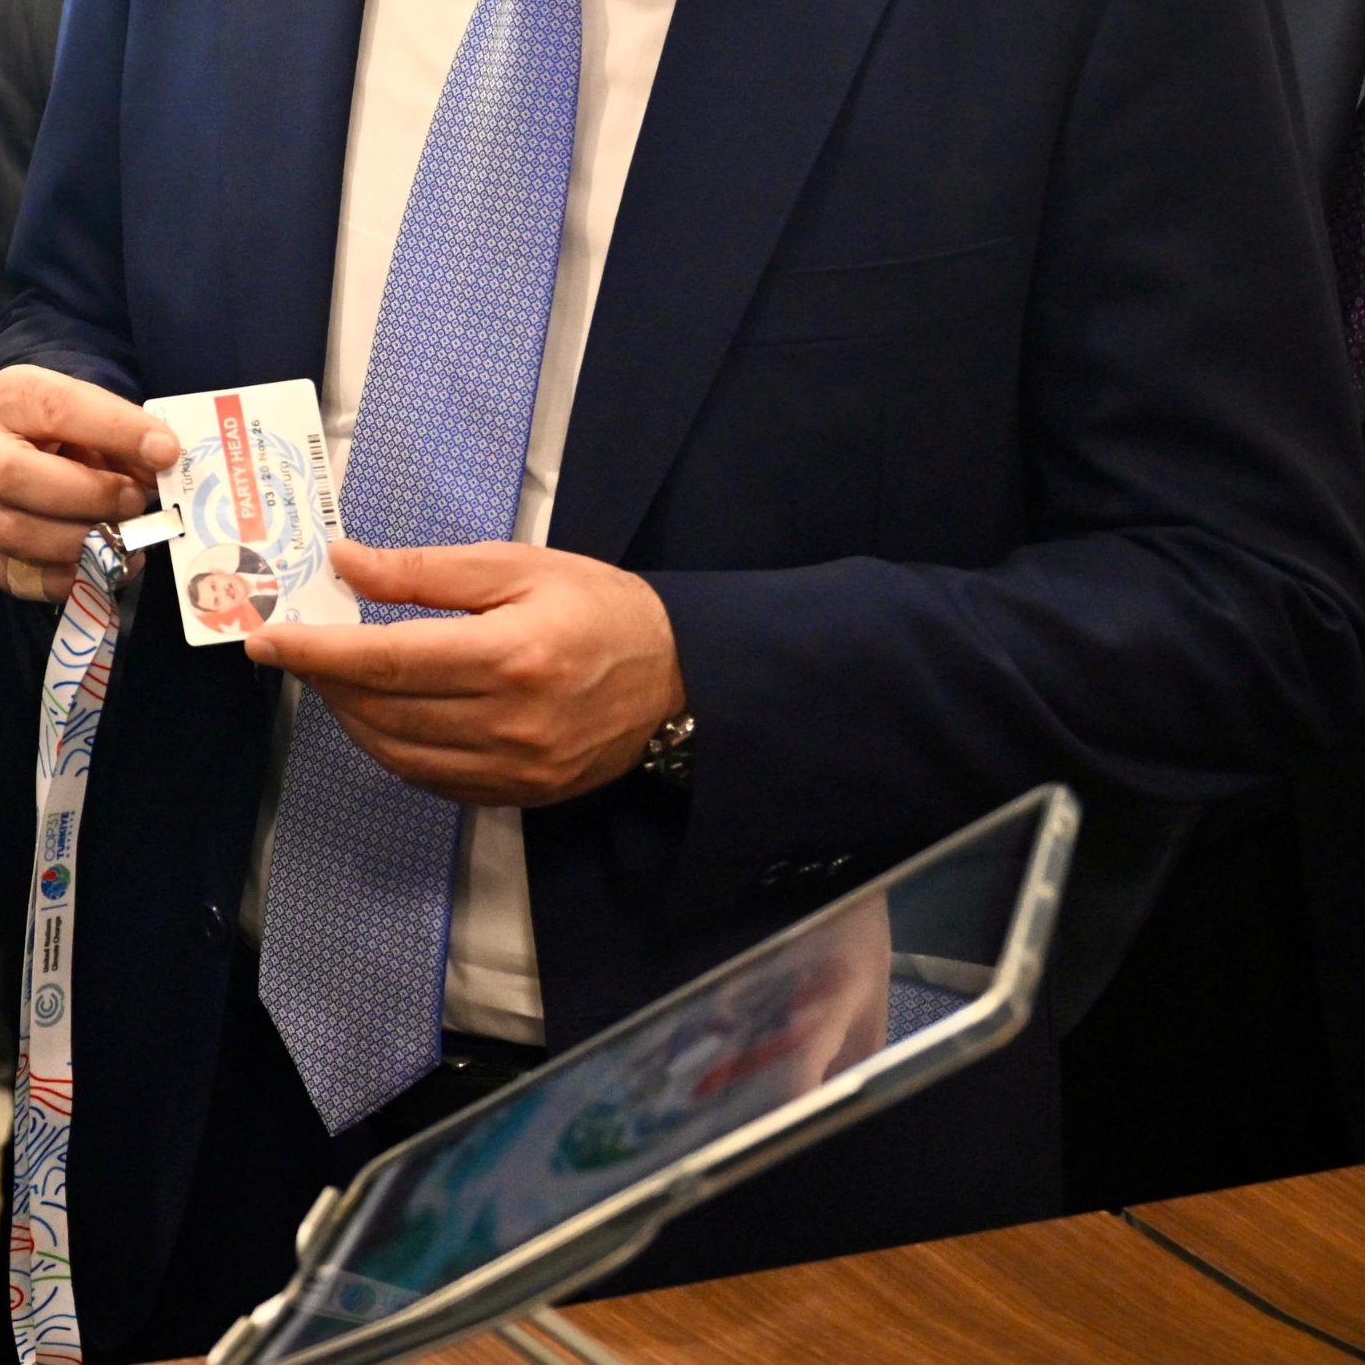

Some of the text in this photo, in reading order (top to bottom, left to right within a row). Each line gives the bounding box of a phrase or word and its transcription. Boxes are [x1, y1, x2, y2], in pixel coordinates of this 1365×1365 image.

[251, 419, 262, 435] 26
[223, 417, 255, 519] PARTY HEAD
[265, 491, 276, 507] 03
[44, 812, 59, 862] COP31
